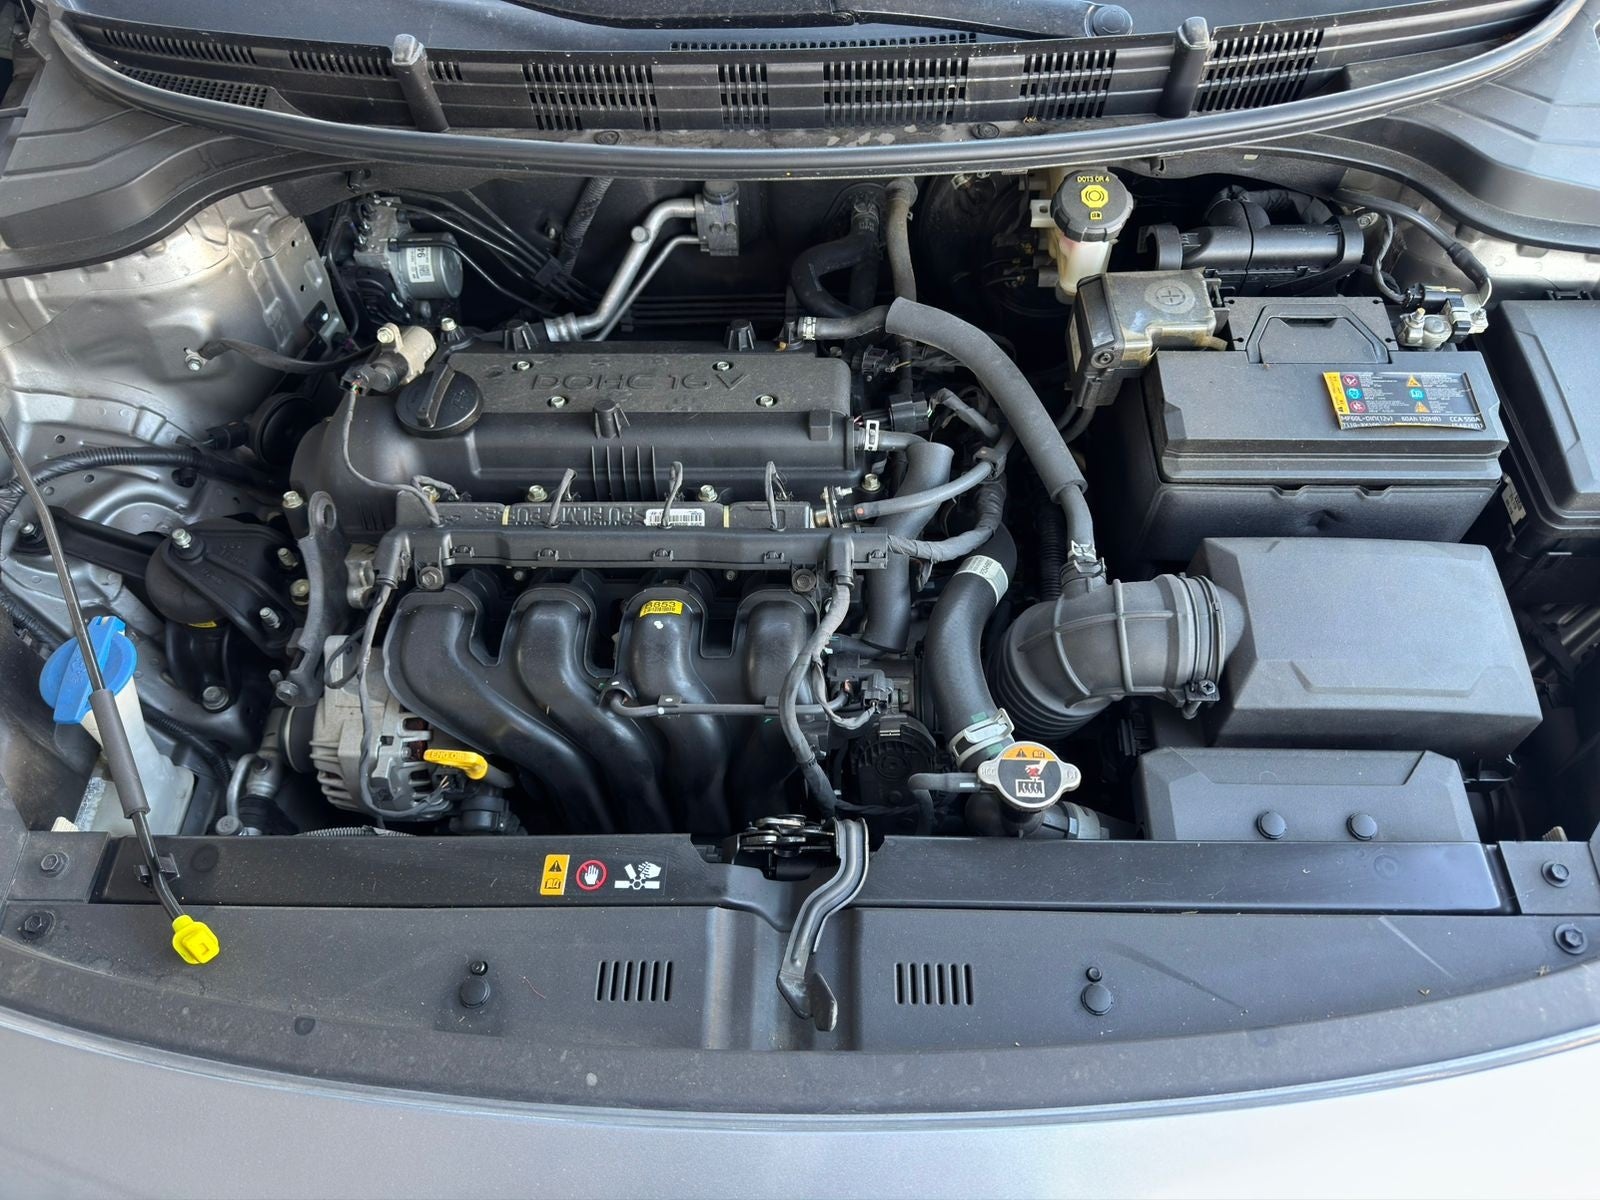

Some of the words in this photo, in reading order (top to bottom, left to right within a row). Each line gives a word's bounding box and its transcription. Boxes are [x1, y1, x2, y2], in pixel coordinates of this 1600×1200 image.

[1077, 175, 1094, 183] DOT3
[1095, 175, 1104, 183] OR
[531, 373, 657, 391] DOHC
